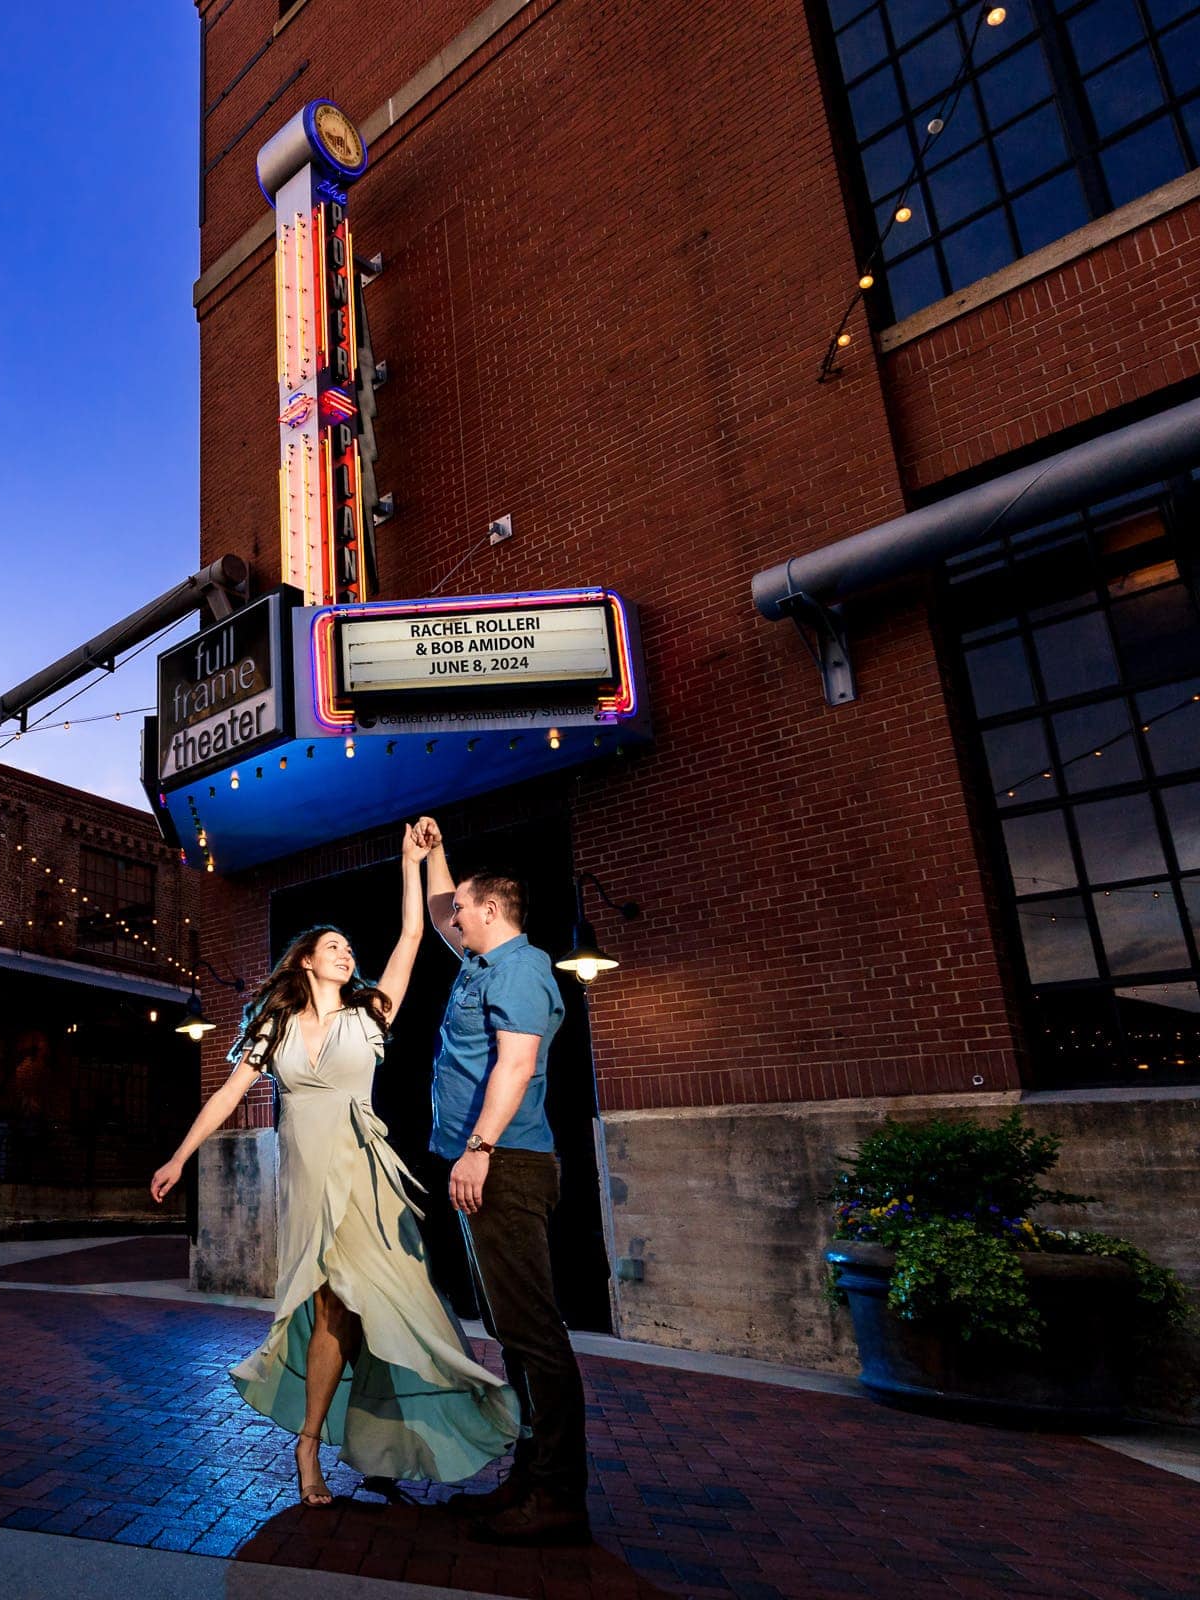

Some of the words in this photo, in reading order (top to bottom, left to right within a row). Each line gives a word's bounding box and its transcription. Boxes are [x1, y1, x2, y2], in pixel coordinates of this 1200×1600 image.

[317, 179, 348, 205] The
[331, 202, 349, 379] POWER
[410, 621, 472, 638] RACHEL
[476, 617, 541, 634] ROLLERI
[195, 624, 235, 681] full
[415, 643, 427, 656] &
[431, 640, 464, 655] BOB
[468, 635, 535, 653] AMIDON
[429, 659, 469, 675] JUNE
[473, 659, 487, 673] 8,
[491, 656, 529, 671] 2024
[173, 656, 256, 723] frame
[379, 712, 425, 725] Center
[426, 710, 444, 723] for
[448, 708, 538, 722] Documentary
[542, 704, 595, 718] Studies
[172, 701, 267, 771] theater
